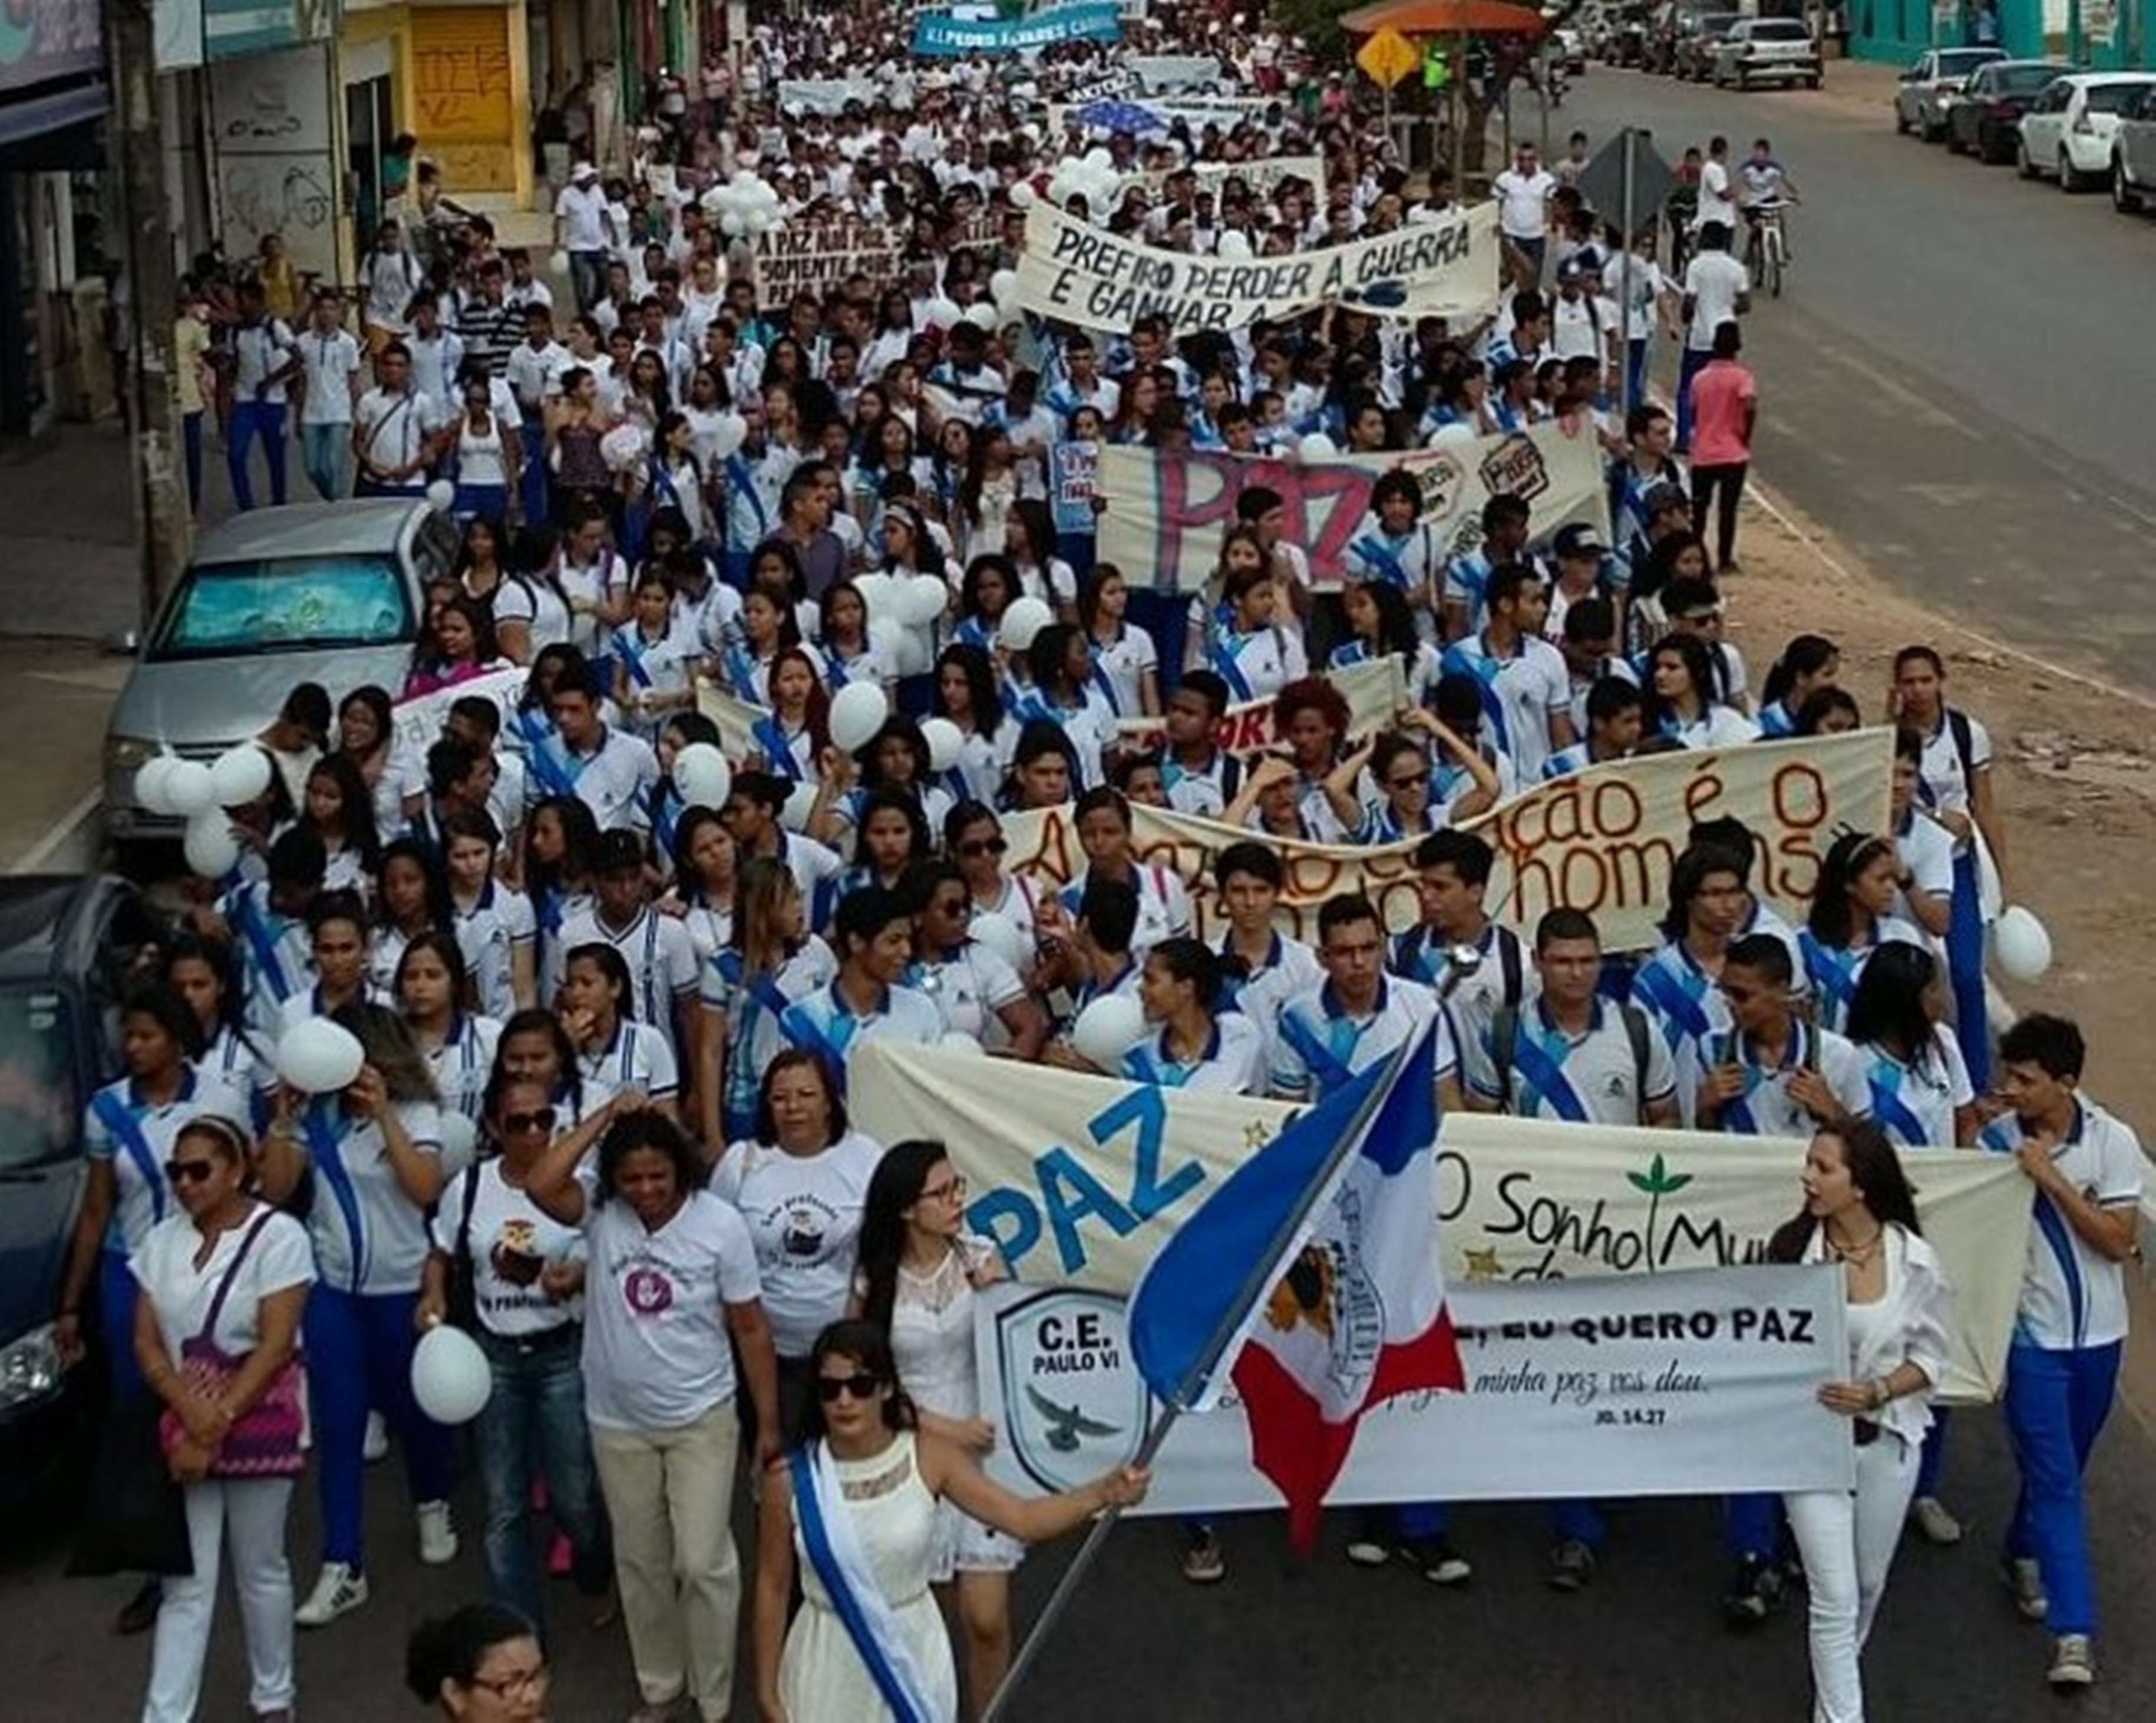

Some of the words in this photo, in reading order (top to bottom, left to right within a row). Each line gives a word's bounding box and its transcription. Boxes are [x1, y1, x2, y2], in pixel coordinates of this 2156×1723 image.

[1052, 227, 1174, 291] PREFIRO
[1184, 261, 1312, 301] PERDER
[1320, 255, 1342, 295] A
[1049, 268, 1078, 305] E
[1087, 280, 1233, 328] GANHAR
[1685, 757, 1724, 825] é
[1513, 832, 1824, 923] homns
[966, 1085, 1207, 1281] PAZ
[1484, 1171, 1643, 1270] Sonho
[1038, 1313, 1112, 1352] C.E.
[1569, 1311, 1718, 1345] QUERO
[1732, 1308, 1814, 1344] PAZ
[1034, 1353, 1096, 1377] PAULO
[1100, 1351, 1120, 1370] VI
[1474, 1359, 1547, 1394] minha
